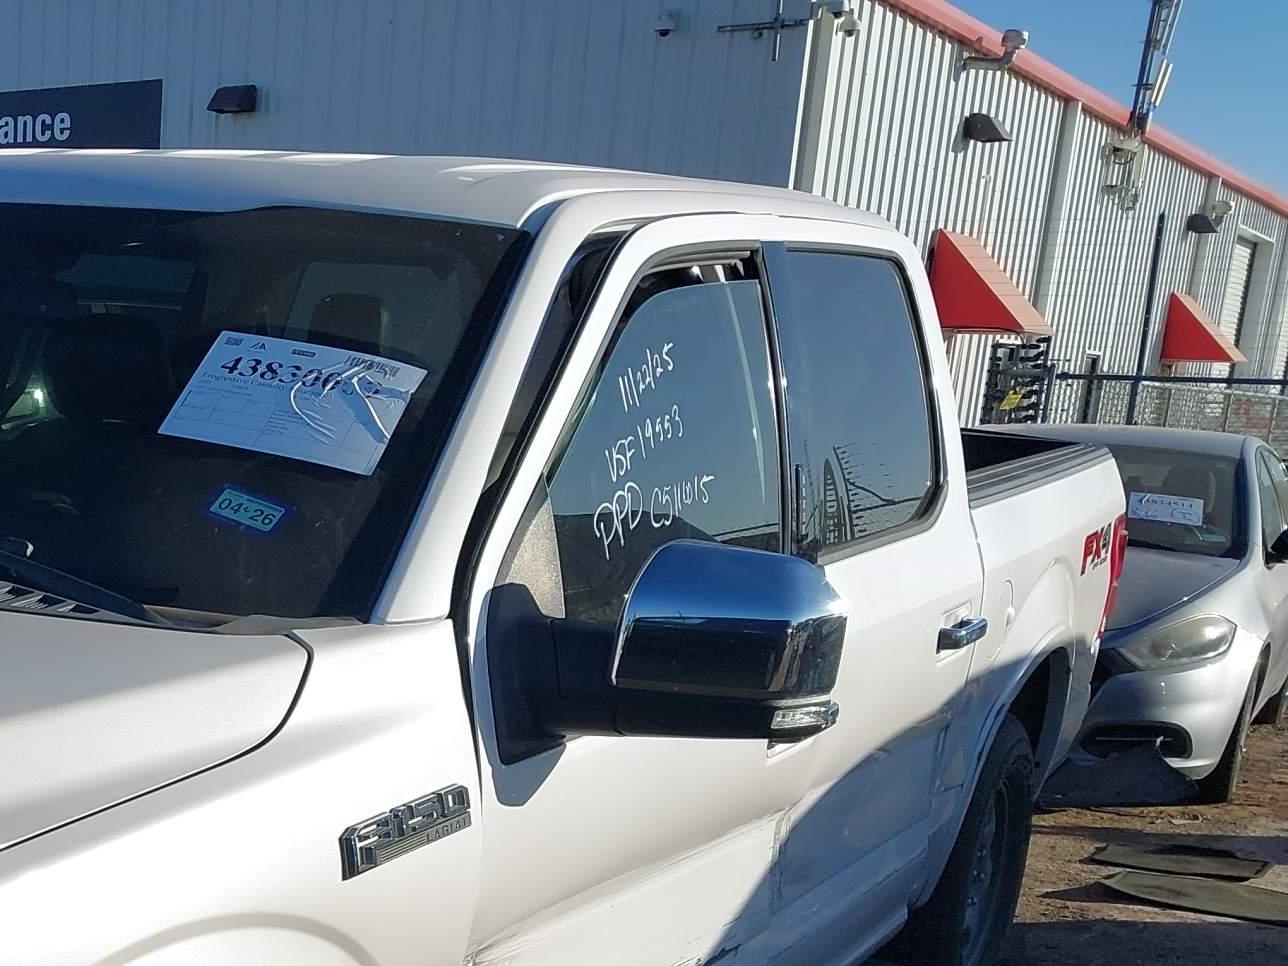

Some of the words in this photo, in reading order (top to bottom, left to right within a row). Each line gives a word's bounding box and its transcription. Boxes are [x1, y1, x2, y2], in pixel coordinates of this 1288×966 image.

[618, 343, 674, 413] 11/22/25
[1079, 521, 1112, 577] FX4
[338, 784, 471, 881] F-150
